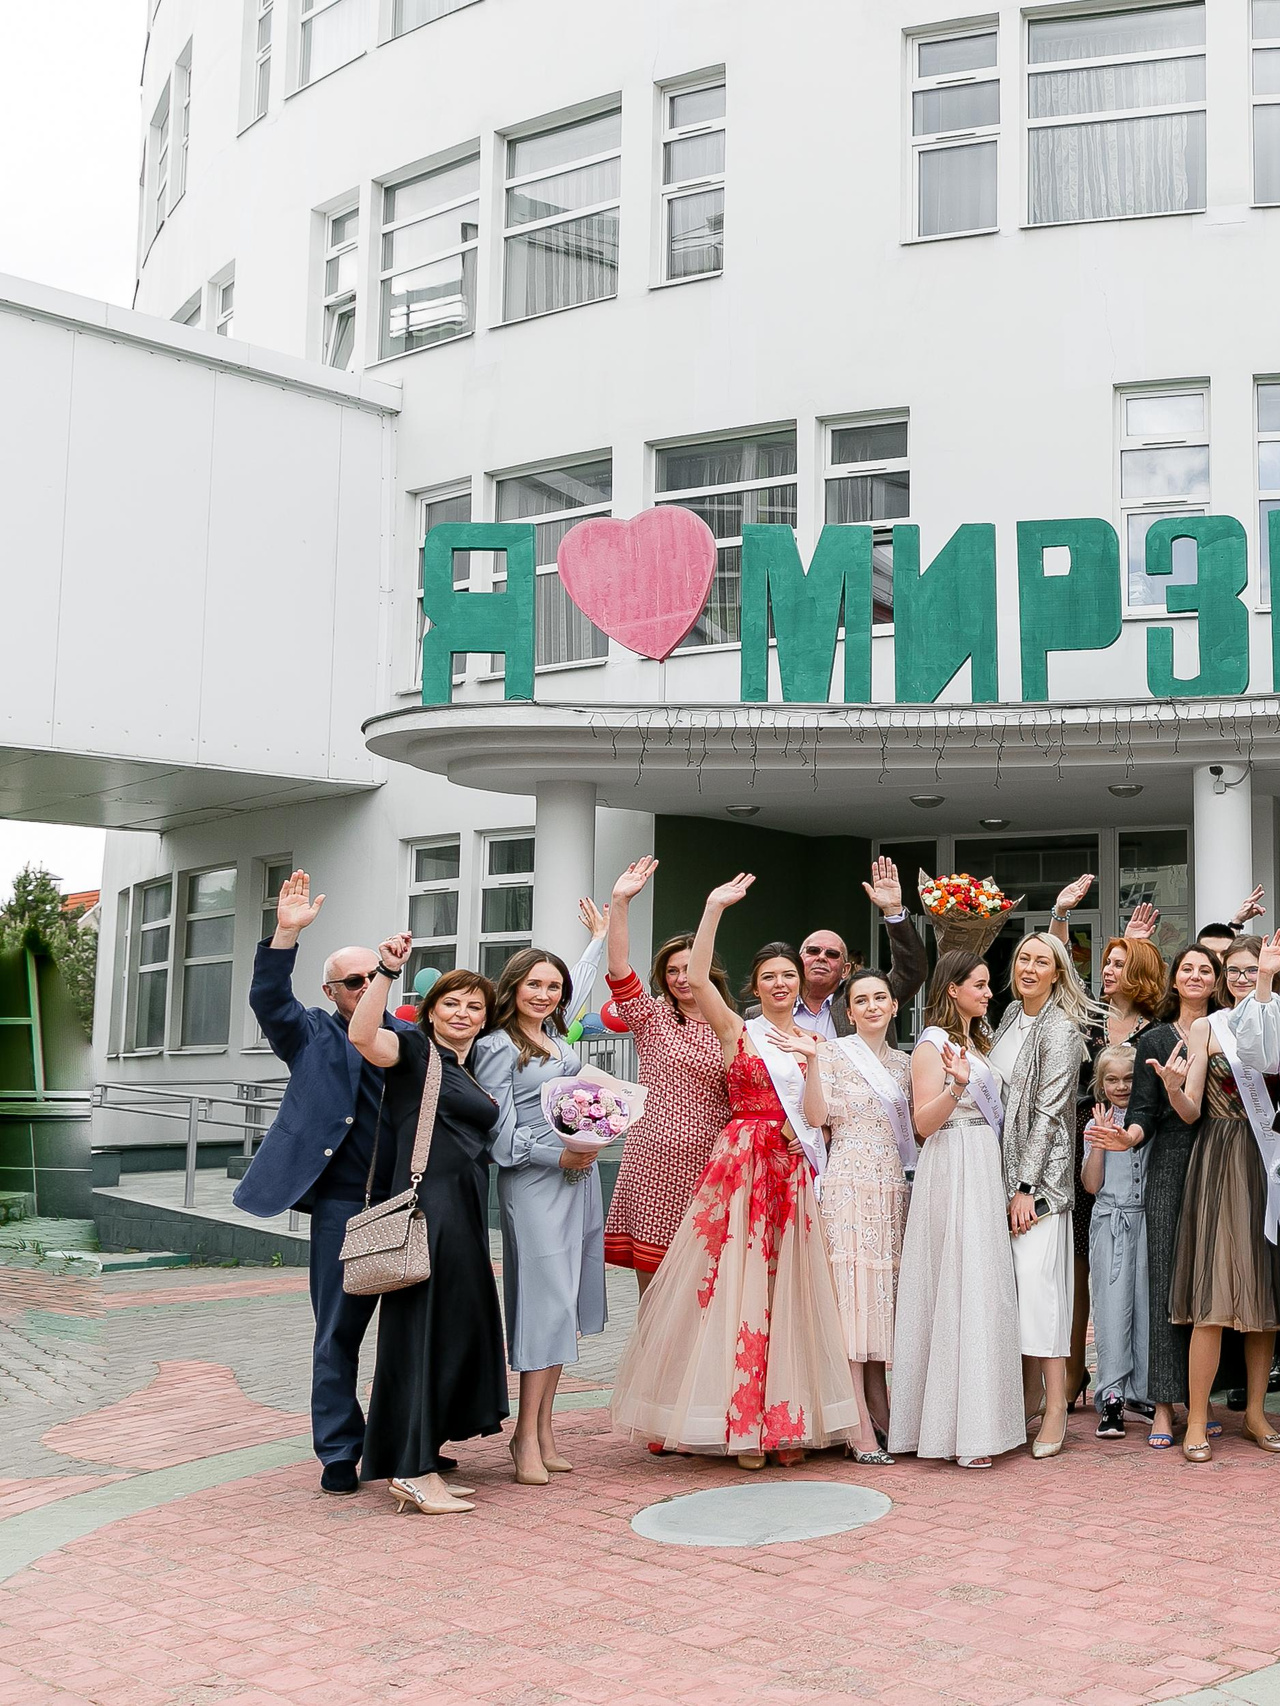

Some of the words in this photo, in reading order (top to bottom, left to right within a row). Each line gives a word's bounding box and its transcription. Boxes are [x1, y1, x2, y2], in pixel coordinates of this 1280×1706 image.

[421, 522, 536, 705] Я
[900, 1122, 911, 1142] 2021
[1260, 1120, 1276, 1142] 2021
